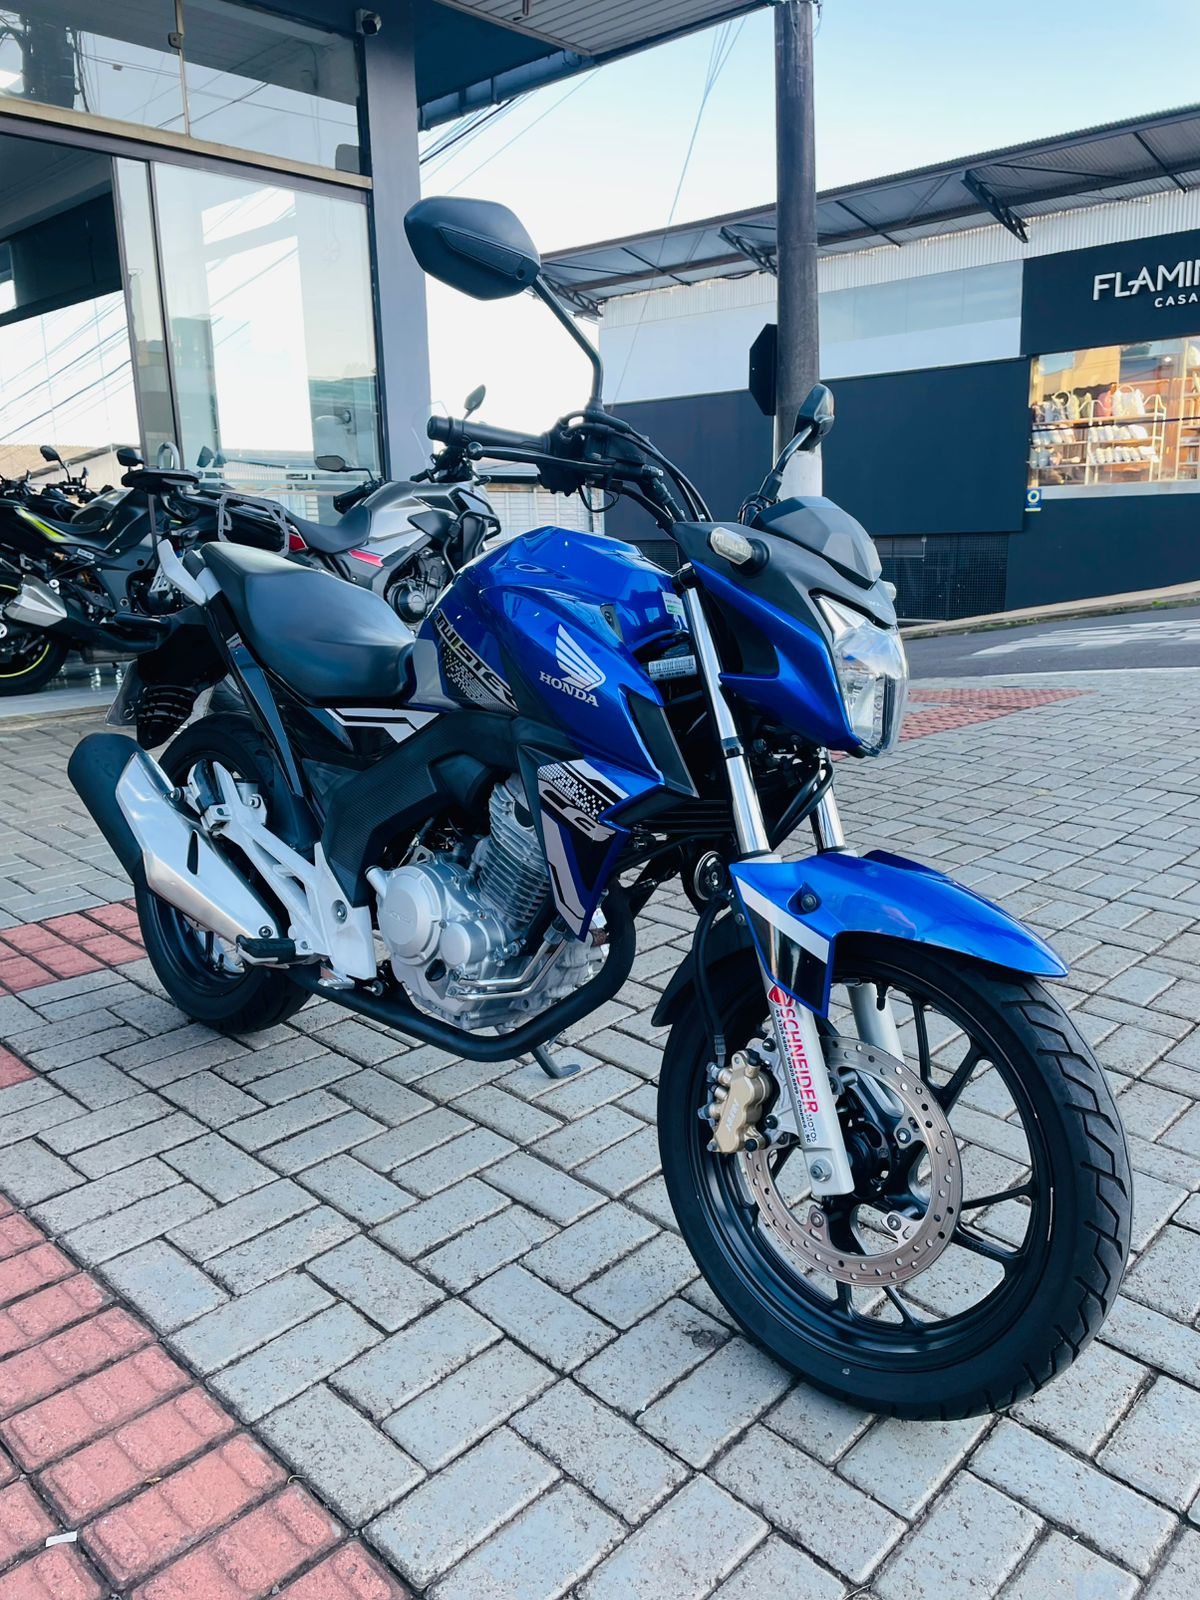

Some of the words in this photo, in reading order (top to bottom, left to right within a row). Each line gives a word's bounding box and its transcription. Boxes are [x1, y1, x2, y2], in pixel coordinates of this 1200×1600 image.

[1154, 292, 1199, 308] CASA
[539, 670, 600, 708] HONDA
[780, 1008, 819, 1113] SCHNEIDER
[806, 1113, 817, 1142] MOTOS
